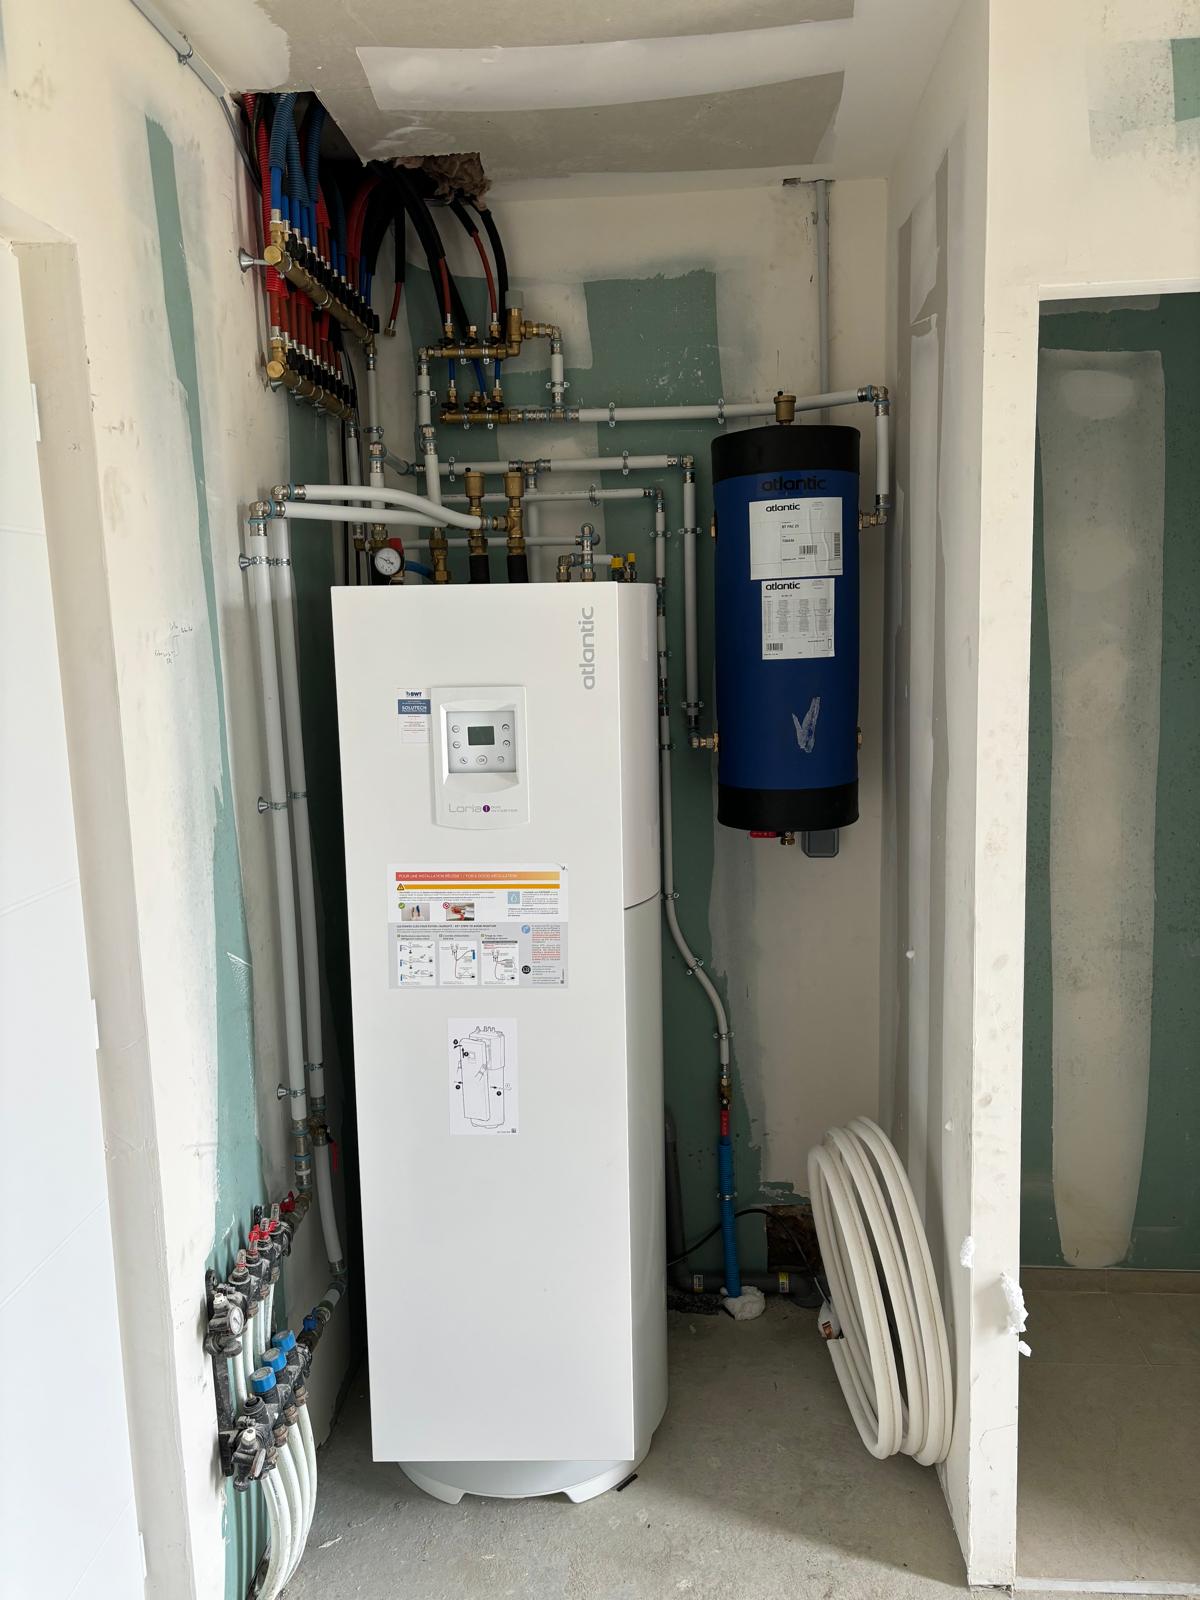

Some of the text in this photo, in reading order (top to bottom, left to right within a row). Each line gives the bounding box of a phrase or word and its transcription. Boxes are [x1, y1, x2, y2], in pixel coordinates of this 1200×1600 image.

[762, 475, 827, 492] atlantic
[766, 502, 800, 512] atlantic
[766, 581, 801, 591] atlantic
[578, 606, 595, 691] atlantic
